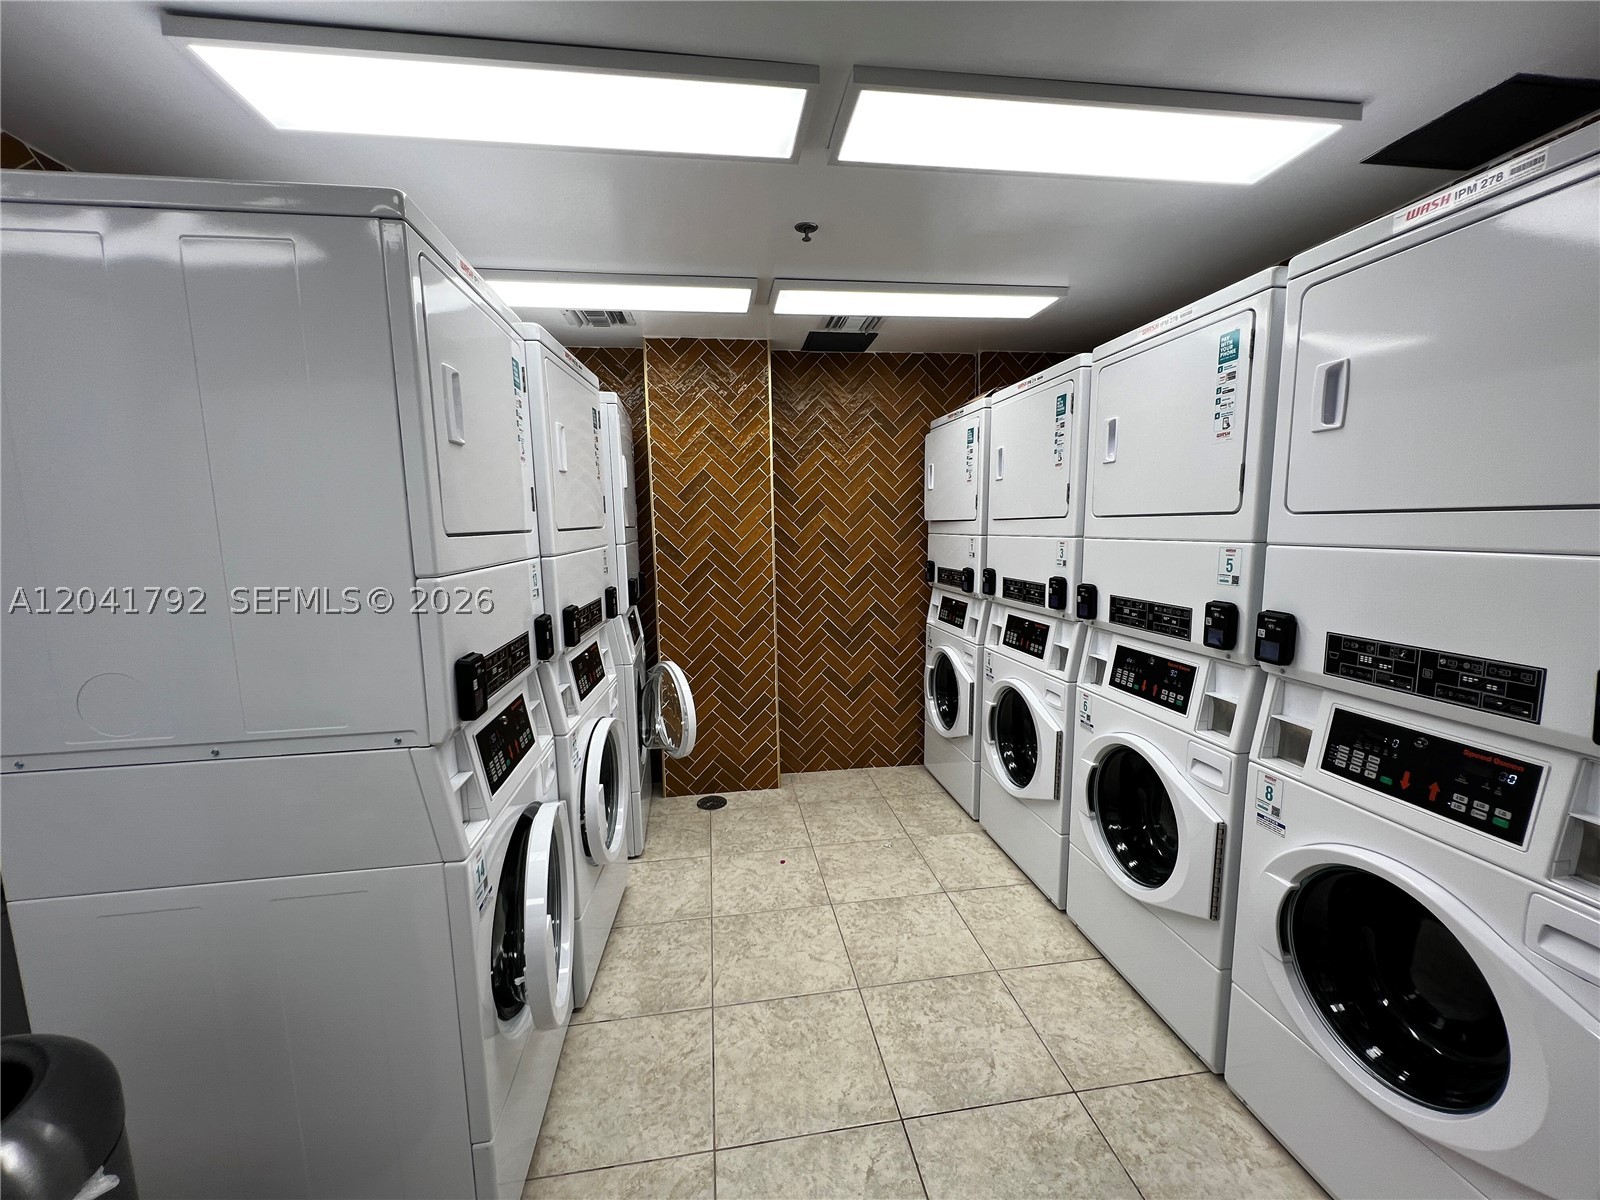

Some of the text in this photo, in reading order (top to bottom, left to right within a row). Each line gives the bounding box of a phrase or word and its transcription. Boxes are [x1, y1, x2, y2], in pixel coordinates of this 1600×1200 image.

[1406, 193, 1452, 221] WASH
[1454, 183, 1478, 201] IPM
[1481, 171, 1504, 189] 278
[1220, 348, 1236, 357] PHONE
[1226, 558, 1234, 573] 5
[1083, 700, 1088, 711] 6
[1463, 749, 1525, 772] Speed Queen
[1265, 785, 1274, 801] 8
[476, 859, 485, 883] 14
